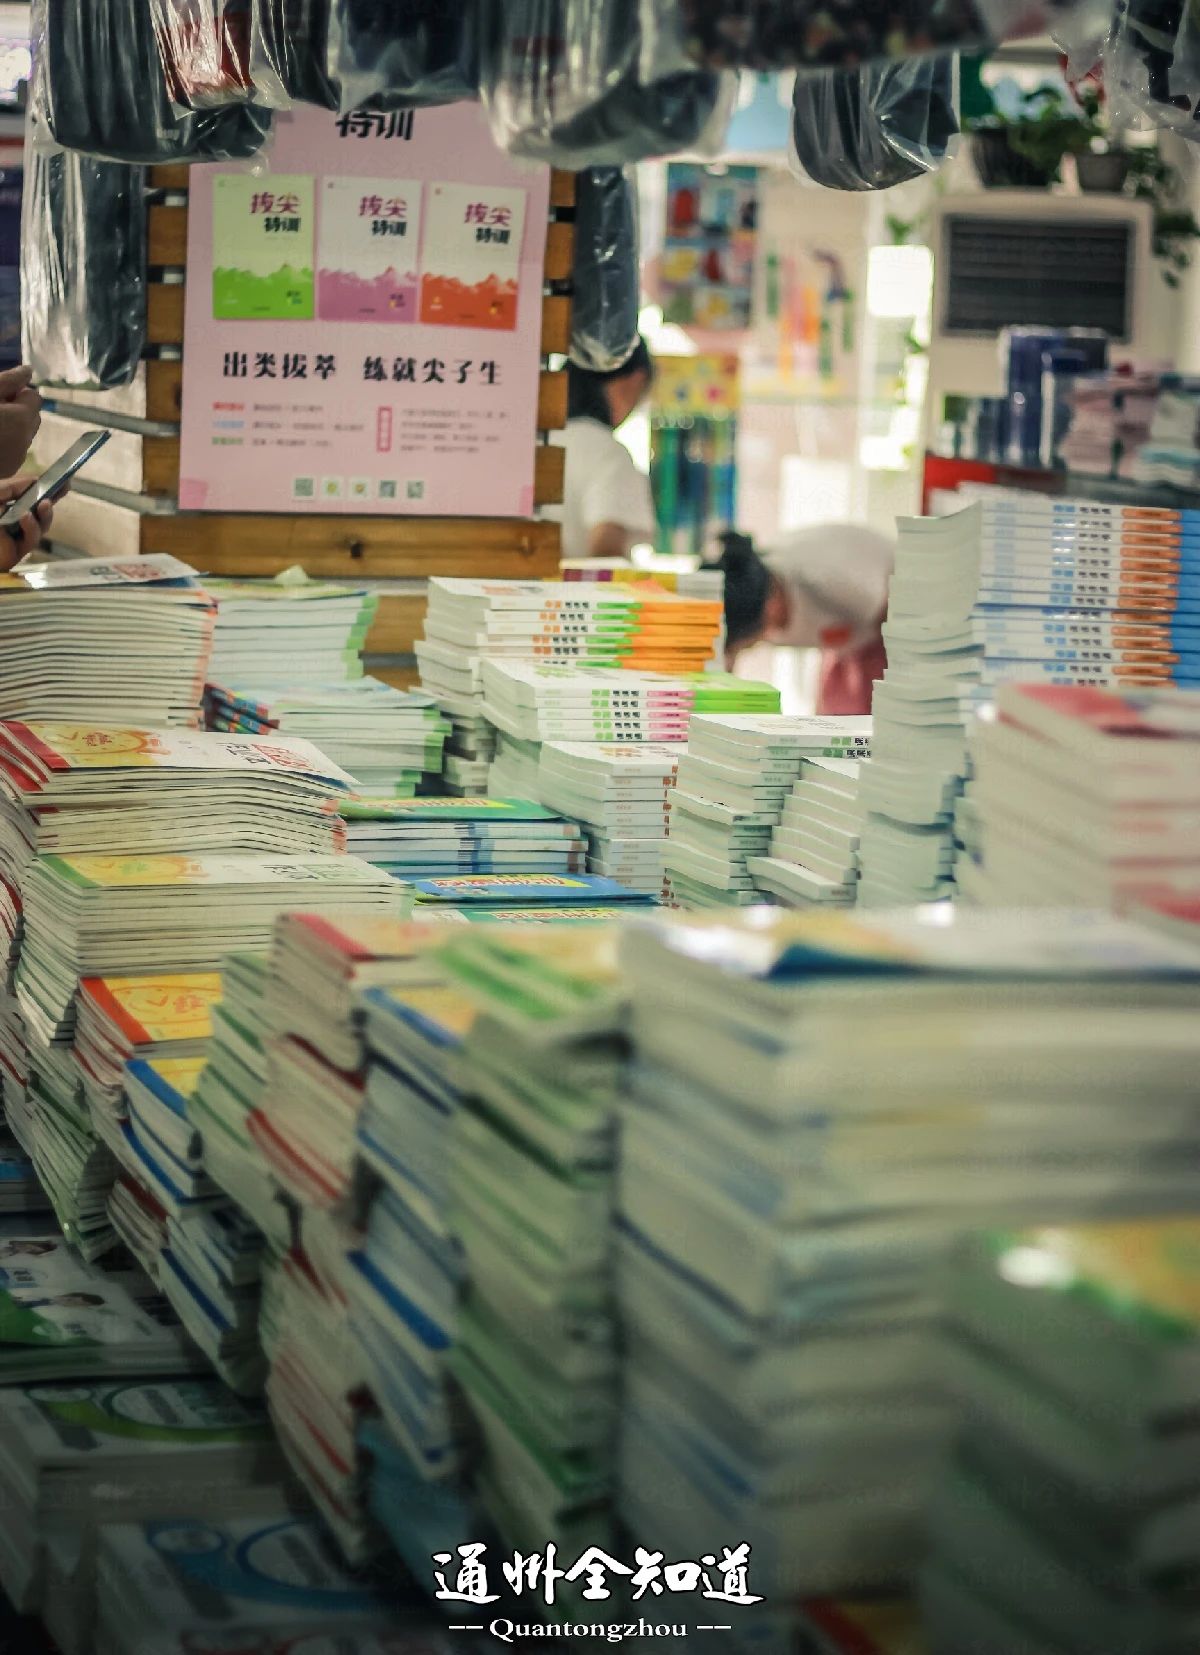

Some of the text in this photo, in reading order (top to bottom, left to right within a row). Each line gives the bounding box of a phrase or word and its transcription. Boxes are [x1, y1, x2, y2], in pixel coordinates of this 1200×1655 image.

[250, 191, 301, 215] 拔尖
[358, 194, 408, 219] 拔尖
[463, 202, 512, 228] 拔尖
[264, 215, 301, 233] 特训
[371, 219, 407, 237] 特训
[475, 227, 511, 246] 特训
[222, 351, 502, 386] 出类拔萃 练就尖子生
